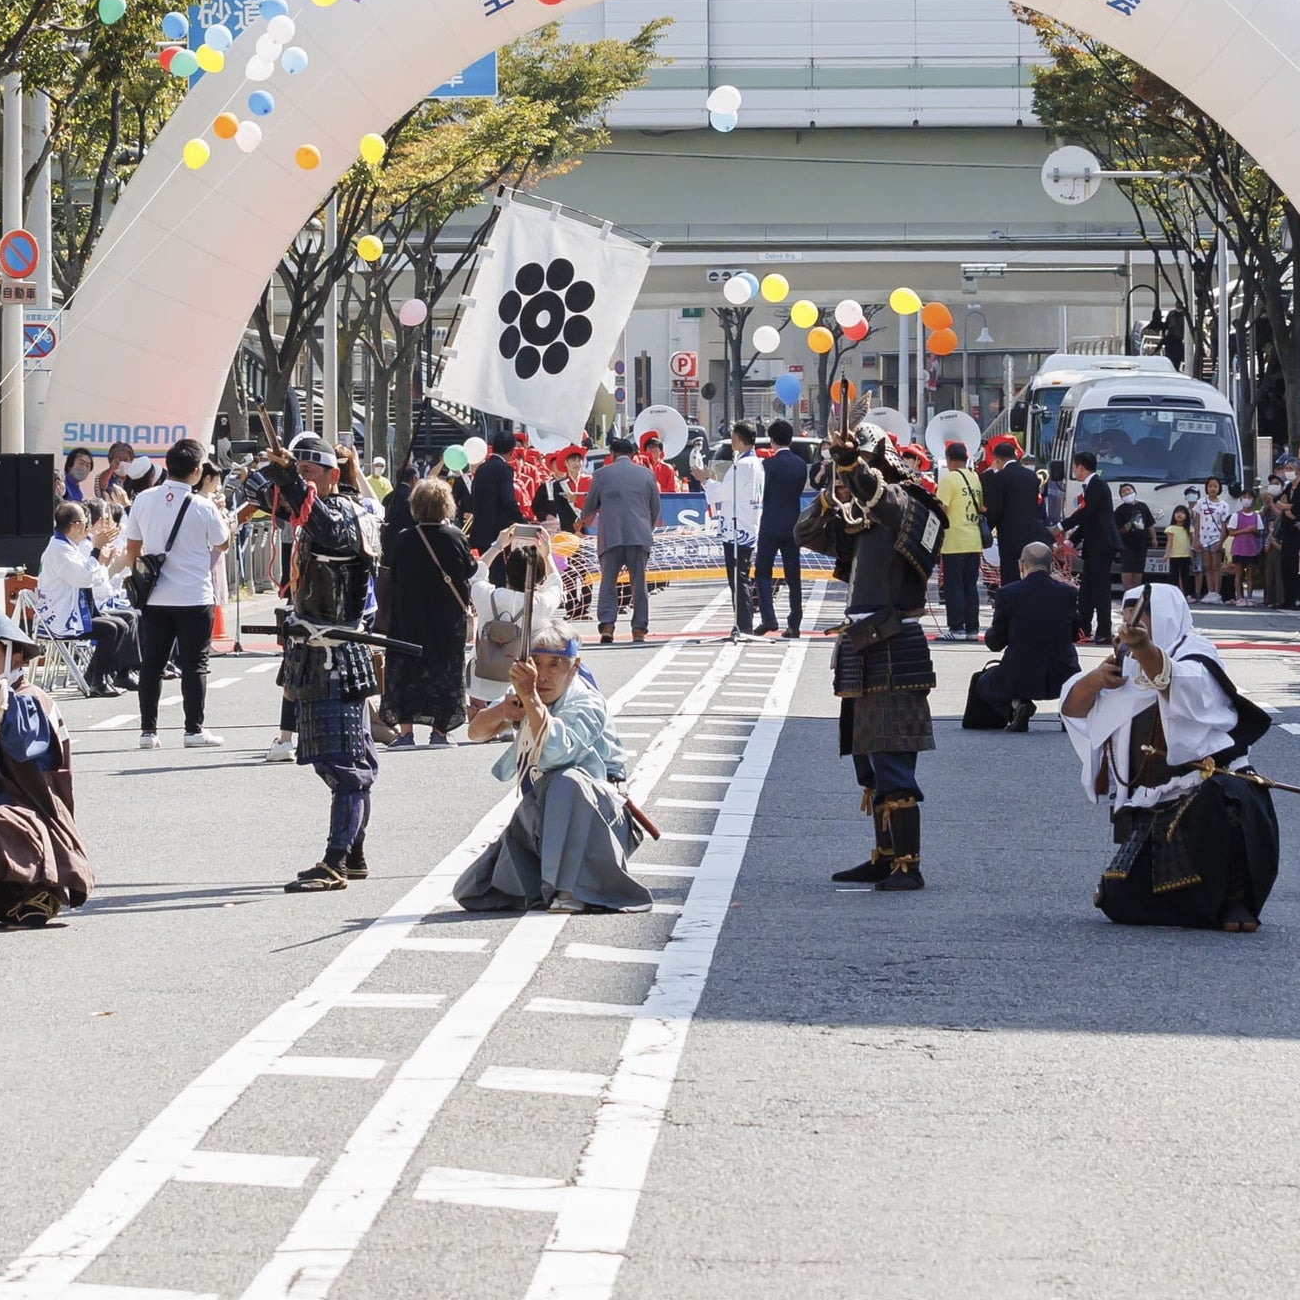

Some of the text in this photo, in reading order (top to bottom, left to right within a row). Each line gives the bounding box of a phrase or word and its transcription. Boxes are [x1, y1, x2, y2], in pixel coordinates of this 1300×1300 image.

[2, 287, 37, 300] 自動車
[63, 421, 188, 445] SHIMANO
